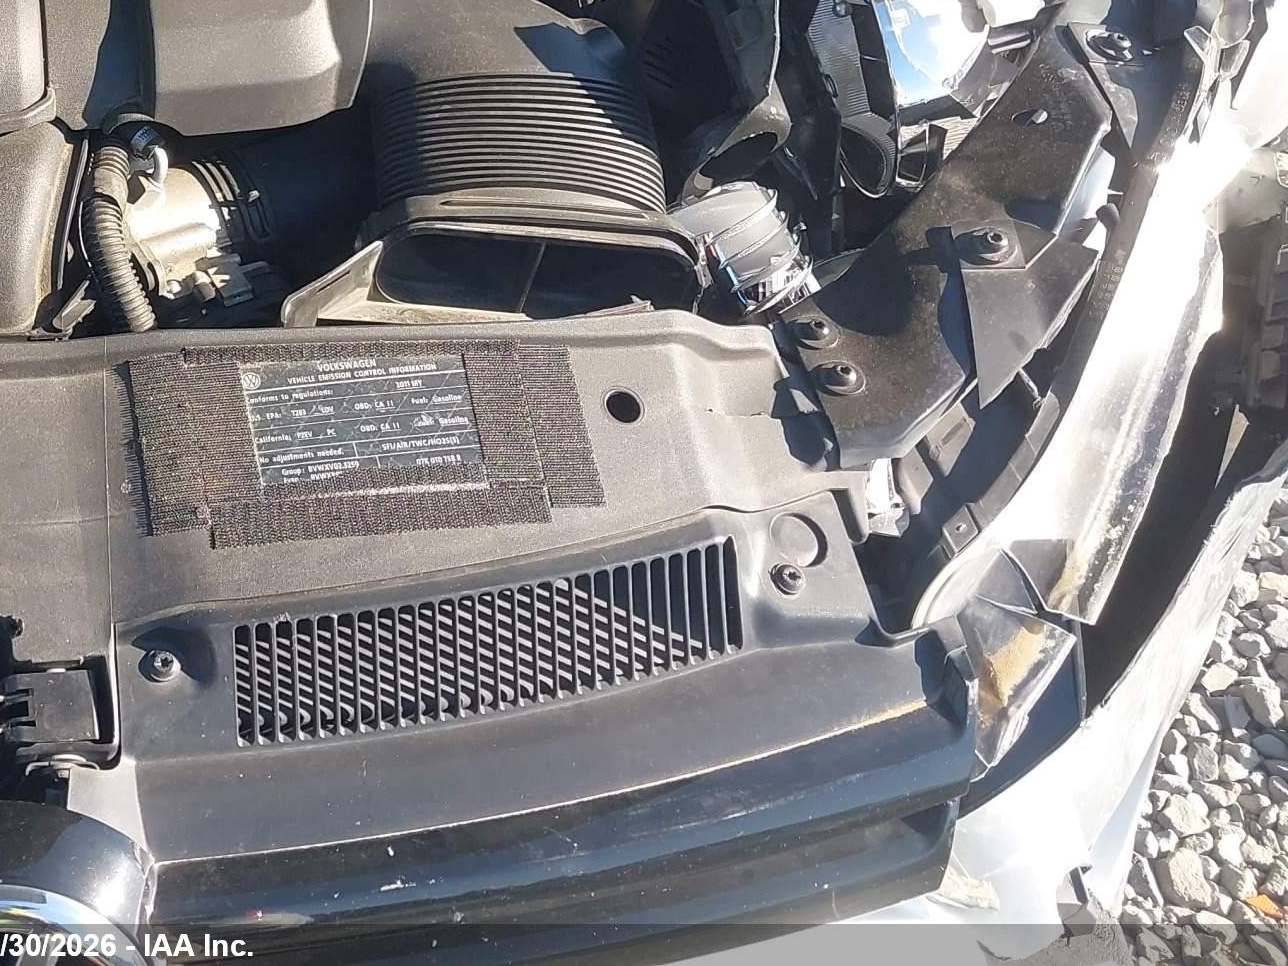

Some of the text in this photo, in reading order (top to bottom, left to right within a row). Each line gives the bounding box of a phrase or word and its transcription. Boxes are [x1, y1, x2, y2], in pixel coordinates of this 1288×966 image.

[317, 359, 376, 372] VOLKSWAGEN
[287, 364, 436, 385] VEHICLE EMISSION CONTROL INFORMATION
[272, 452, 314, 463] adjustments
[318, 448, 344, 456] needed.
